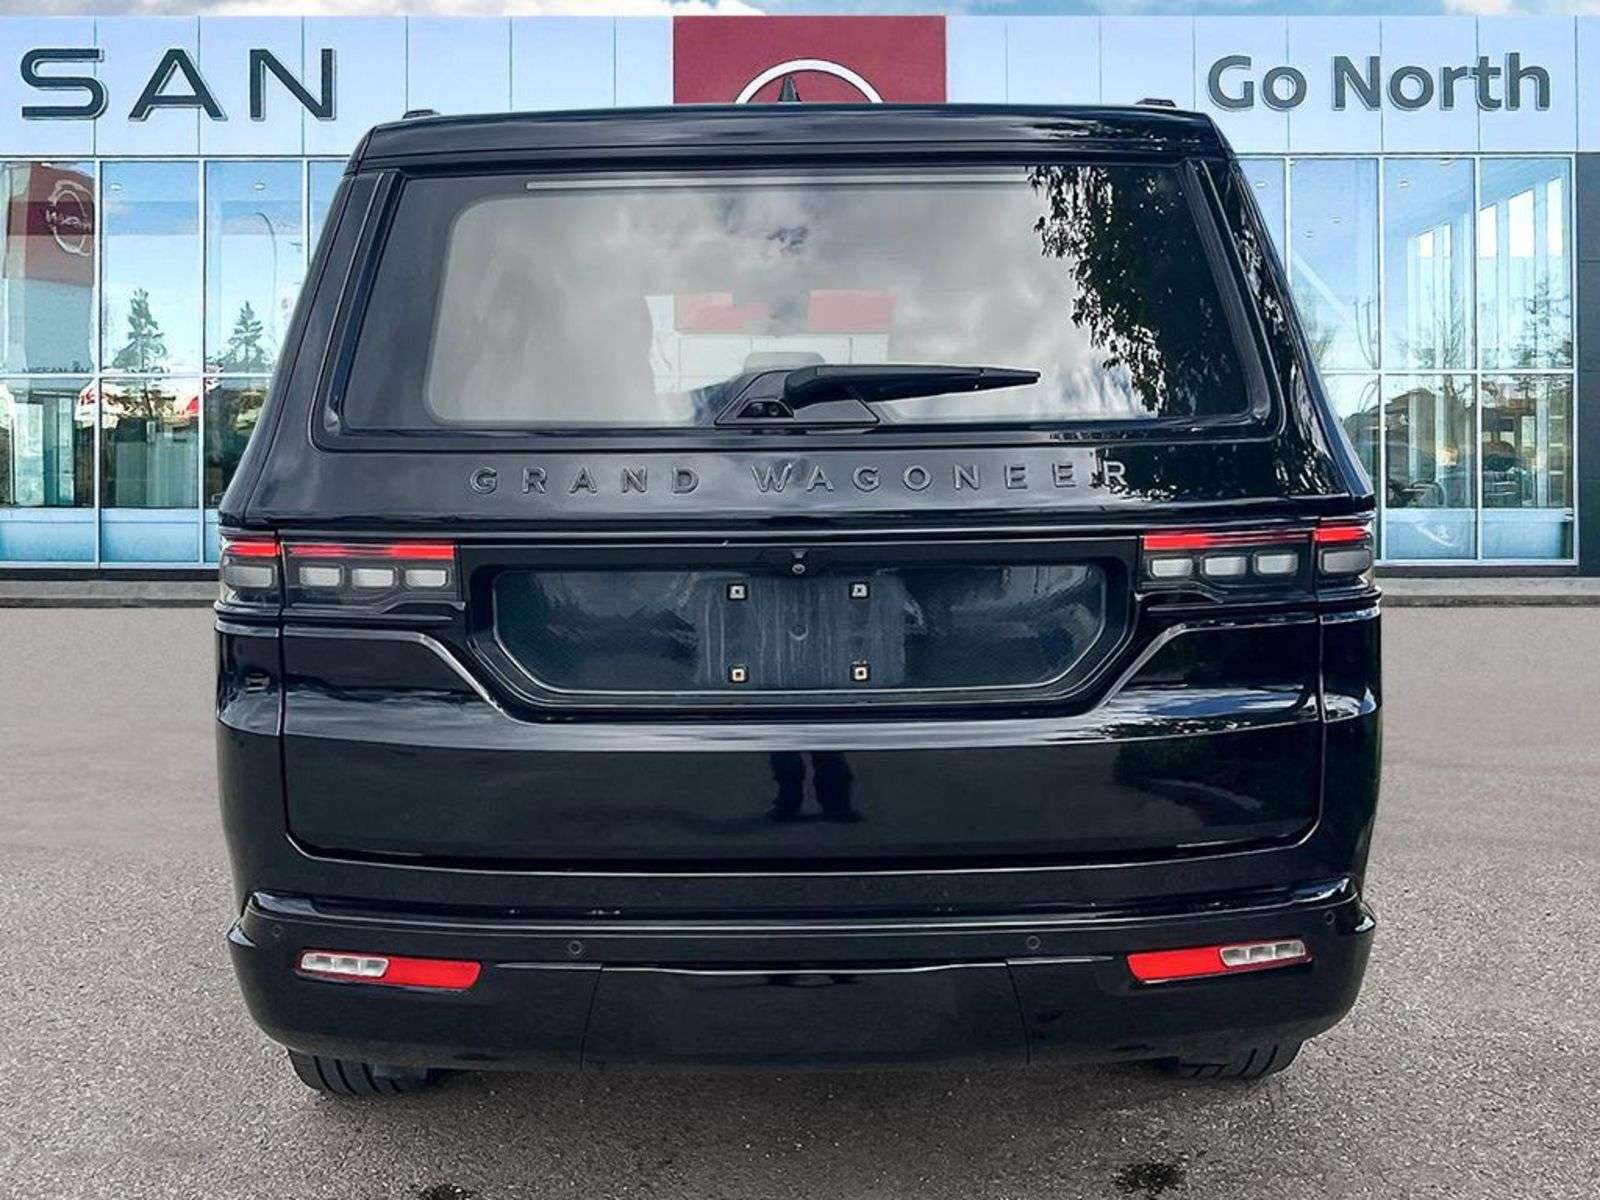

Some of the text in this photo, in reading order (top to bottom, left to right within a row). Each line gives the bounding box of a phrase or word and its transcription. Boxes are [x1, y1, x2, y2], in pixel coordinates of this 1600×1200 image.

[20, 48, 336, 121] SAN
[1207, 52, 1551, 111] Go North
[469, 460, 1129, 495] GRAND WAGONEER
